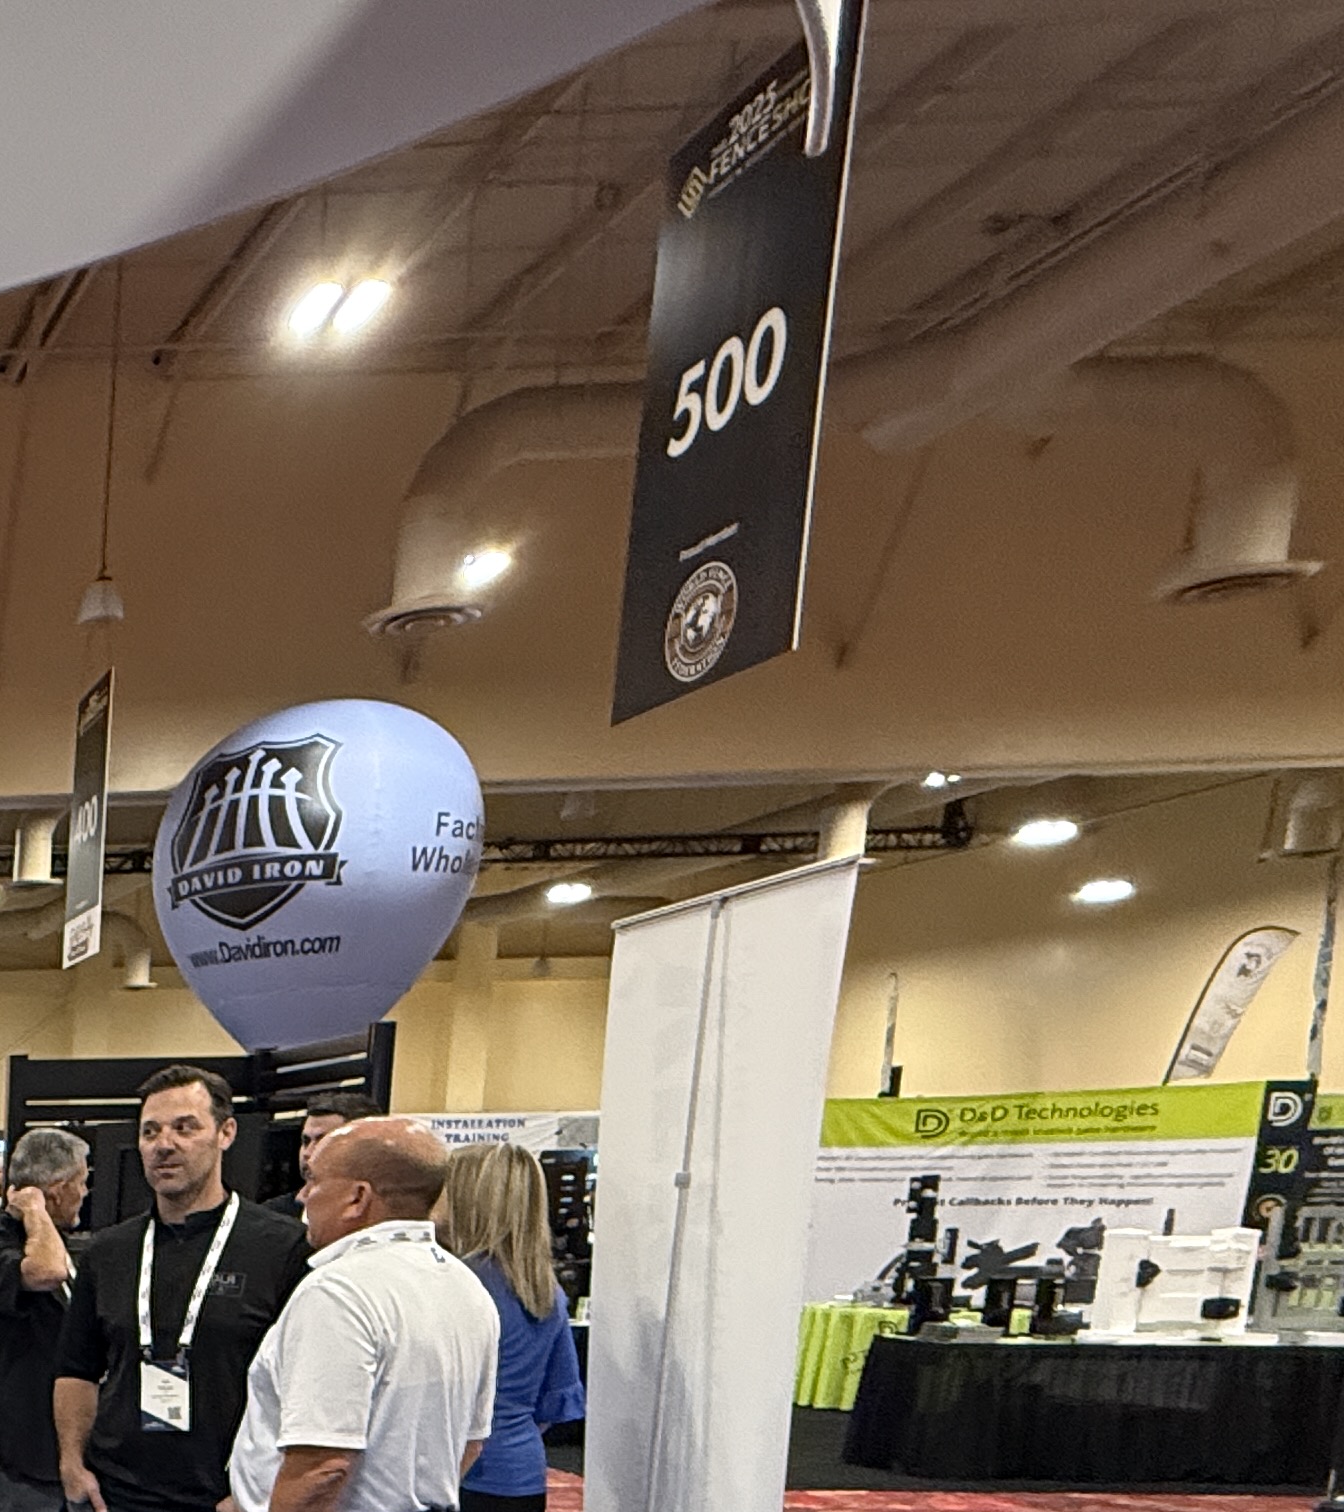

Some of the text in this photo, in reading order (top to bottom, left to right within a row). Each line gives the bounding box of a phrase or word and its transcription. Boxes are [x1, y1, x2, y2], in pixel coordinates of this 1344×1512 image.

[666, 306, 787, 458] 500
[177, 859, 325, 897] DAVID IRON
[189, 935, 341, 968] www.Davidiron.com
[1013, 1100, 1160, 1122] Technologies
[430, 1118, 527, 1130] INSTALLATION
[444, 1132, 510, 1144] TRAINING
[1258, 1148, 1300, 1175] 30
[948, 1196, 1012, 1207] Callbacks
[1014, 1196, 1059, 1207] Before
[1063, 1196, 1095, 1208] They
